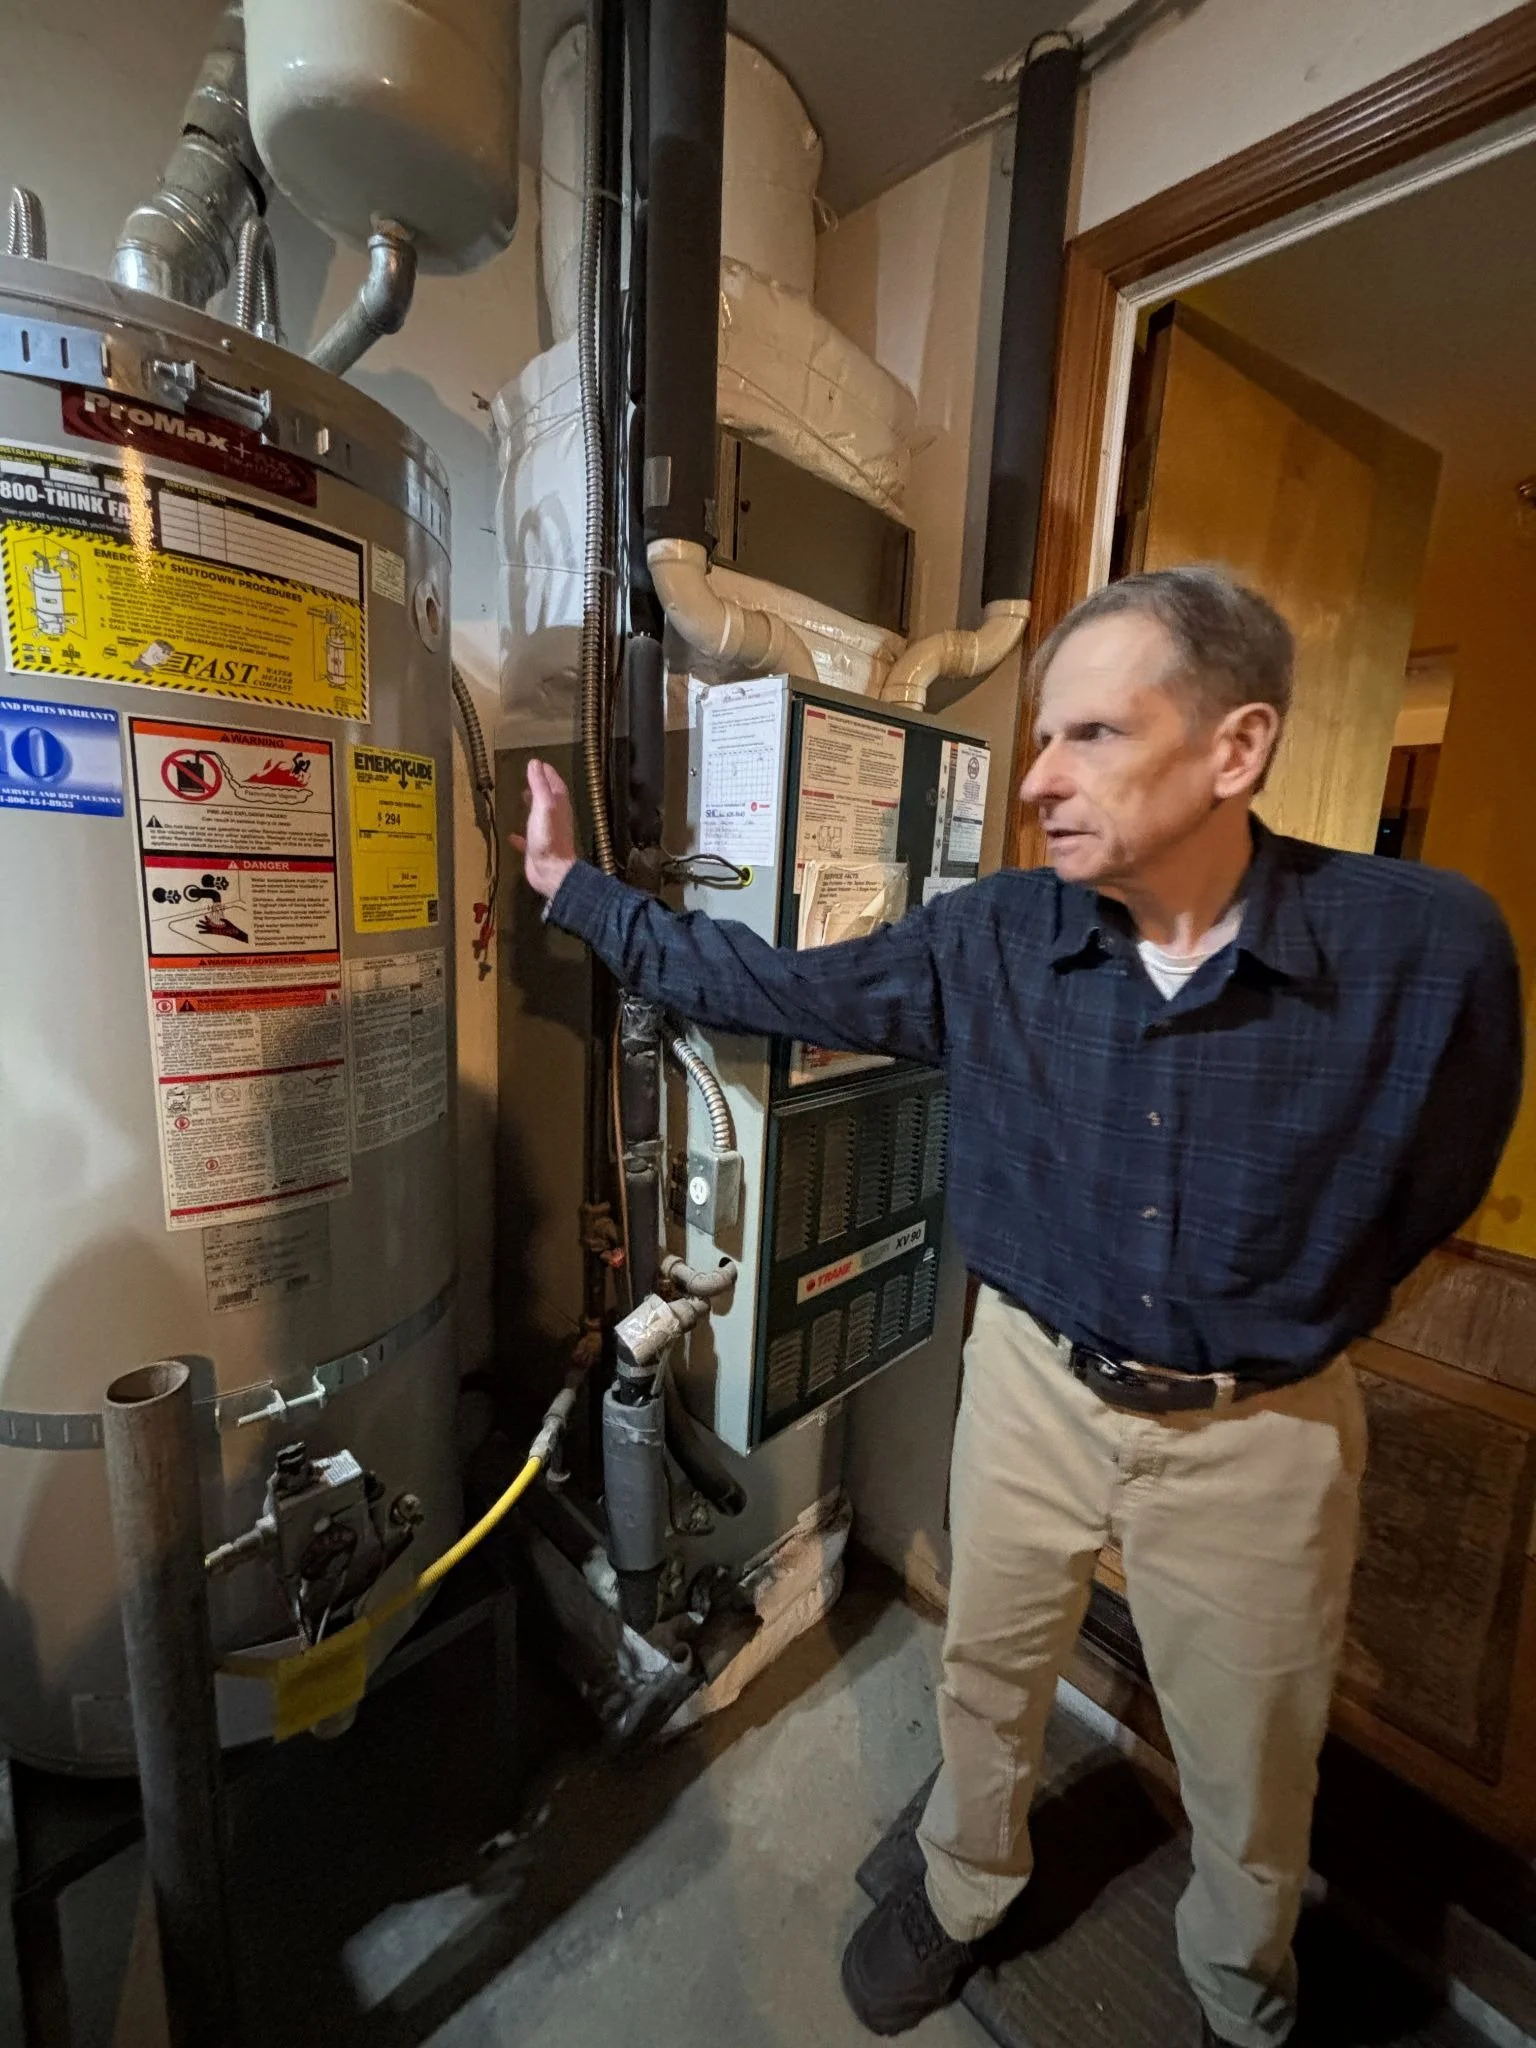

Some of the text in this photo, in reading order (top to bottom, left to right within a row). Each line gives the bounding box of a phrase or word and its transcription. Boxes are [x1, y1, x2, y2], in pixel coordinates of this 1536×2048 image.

[94, 548, 166, 570] EMERGCY
[170, 563, 236, 586] SHUTDOWN
[239, 579, 303, 603] PROCEDURES
[181, 651, 259, 685] FAST
[22, 704, 56, 714] PARTS
[57, 708, 116, 722] WARRANTY
[230, 734, 285, 749] WARNING
[354, 752, 433, 780] ENERGYGUIDE
[2, 788, 121, 804] SERVICE AND REPLACEMENT
[385, 812, 401, 825] 294
[243, 860, 290, 870] DANGER
[208, 958, 248, 966] WARNING
[896, 1228, 922, 1250] XV 90
